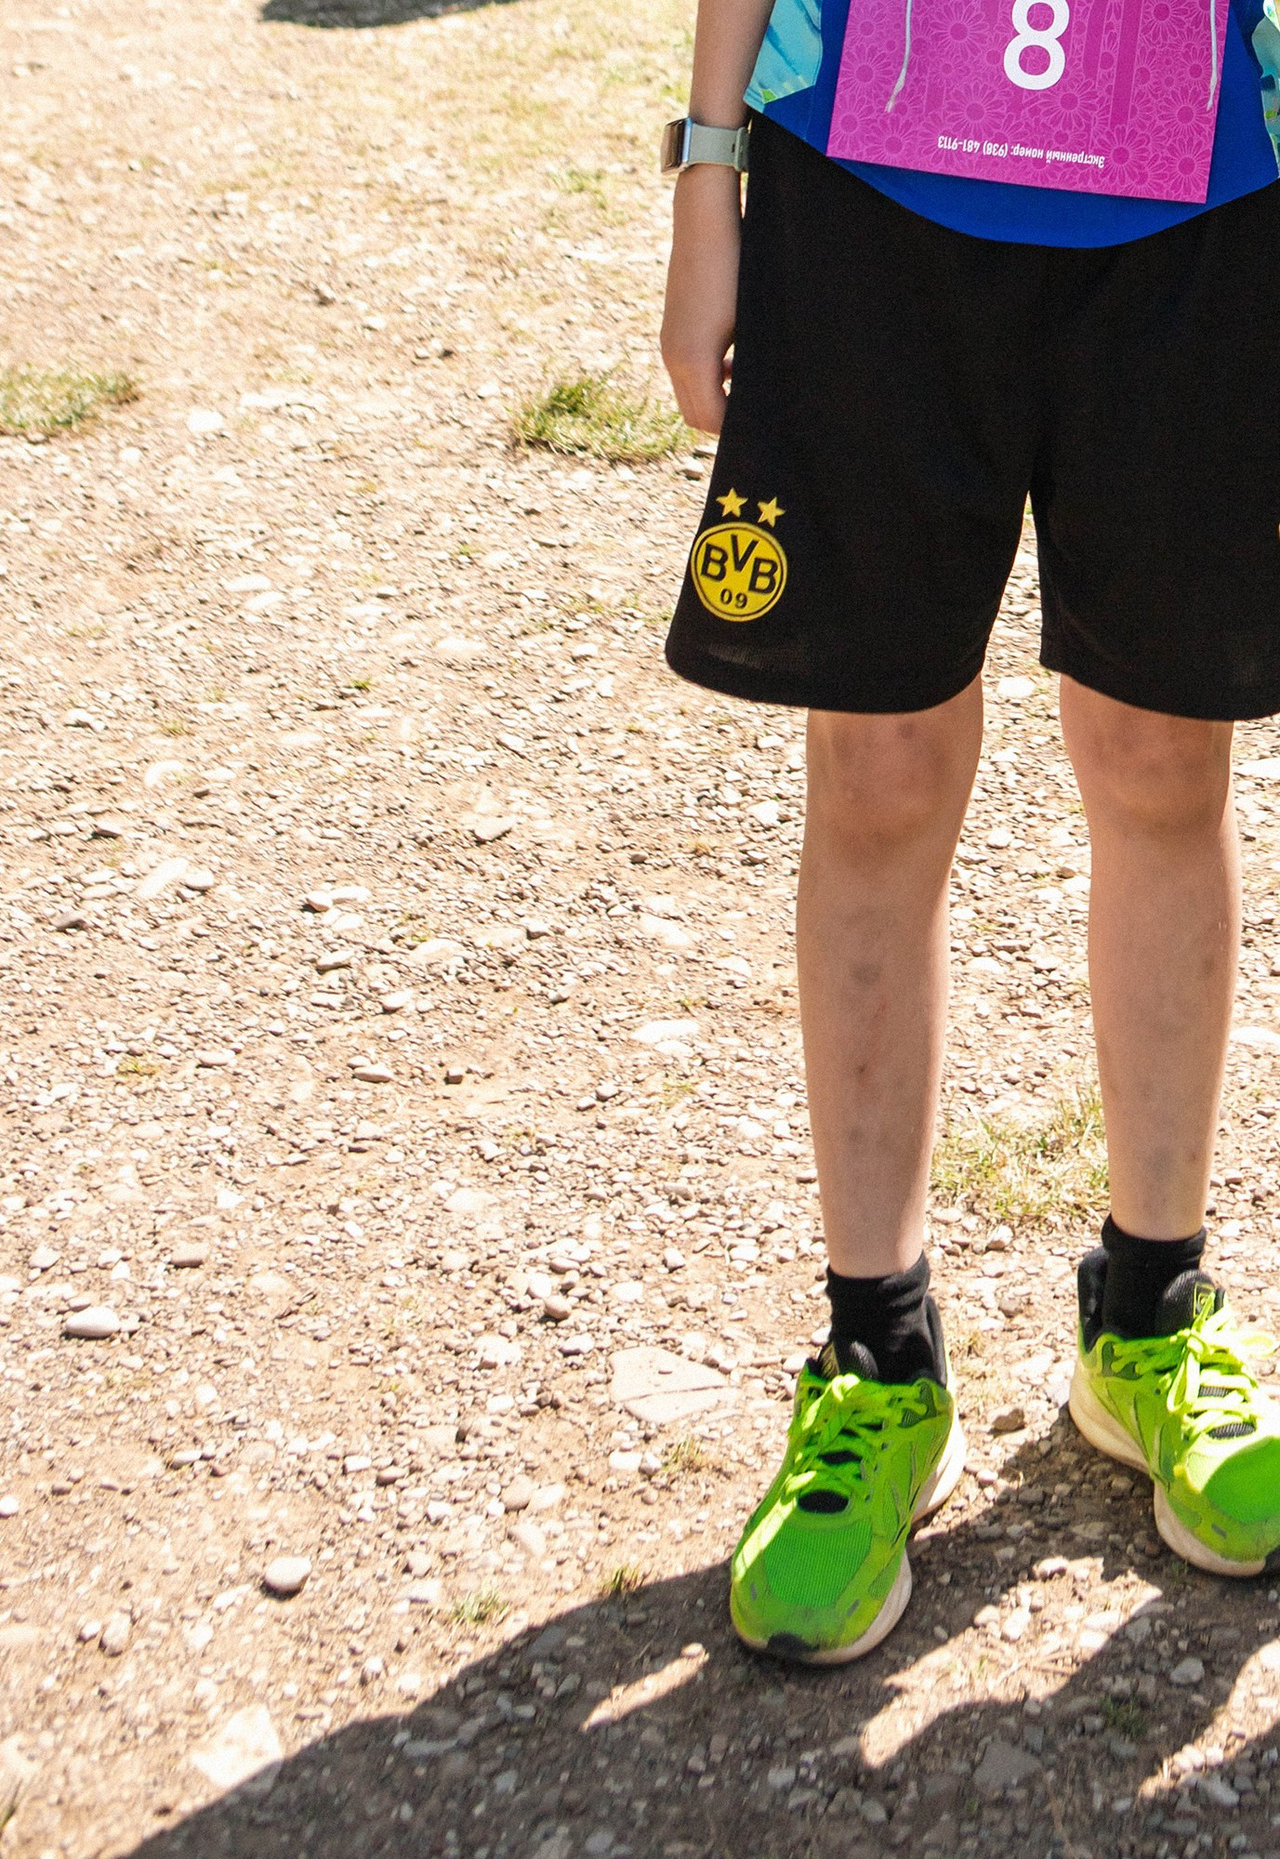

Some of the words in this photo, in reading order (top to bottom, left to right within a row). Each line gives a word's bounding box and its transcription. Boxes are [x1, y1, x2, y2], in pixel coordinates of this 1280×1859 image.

[937, 135, 981, 153] 481-9113
[982, 140, 1008, 158] (938)
[1010, 143, 1043, 159] номер:
[1046, 149, 1105, 168] Экстренный
[700, 533, 778, 595] BVB
[720, 588, 748, 609] 09
